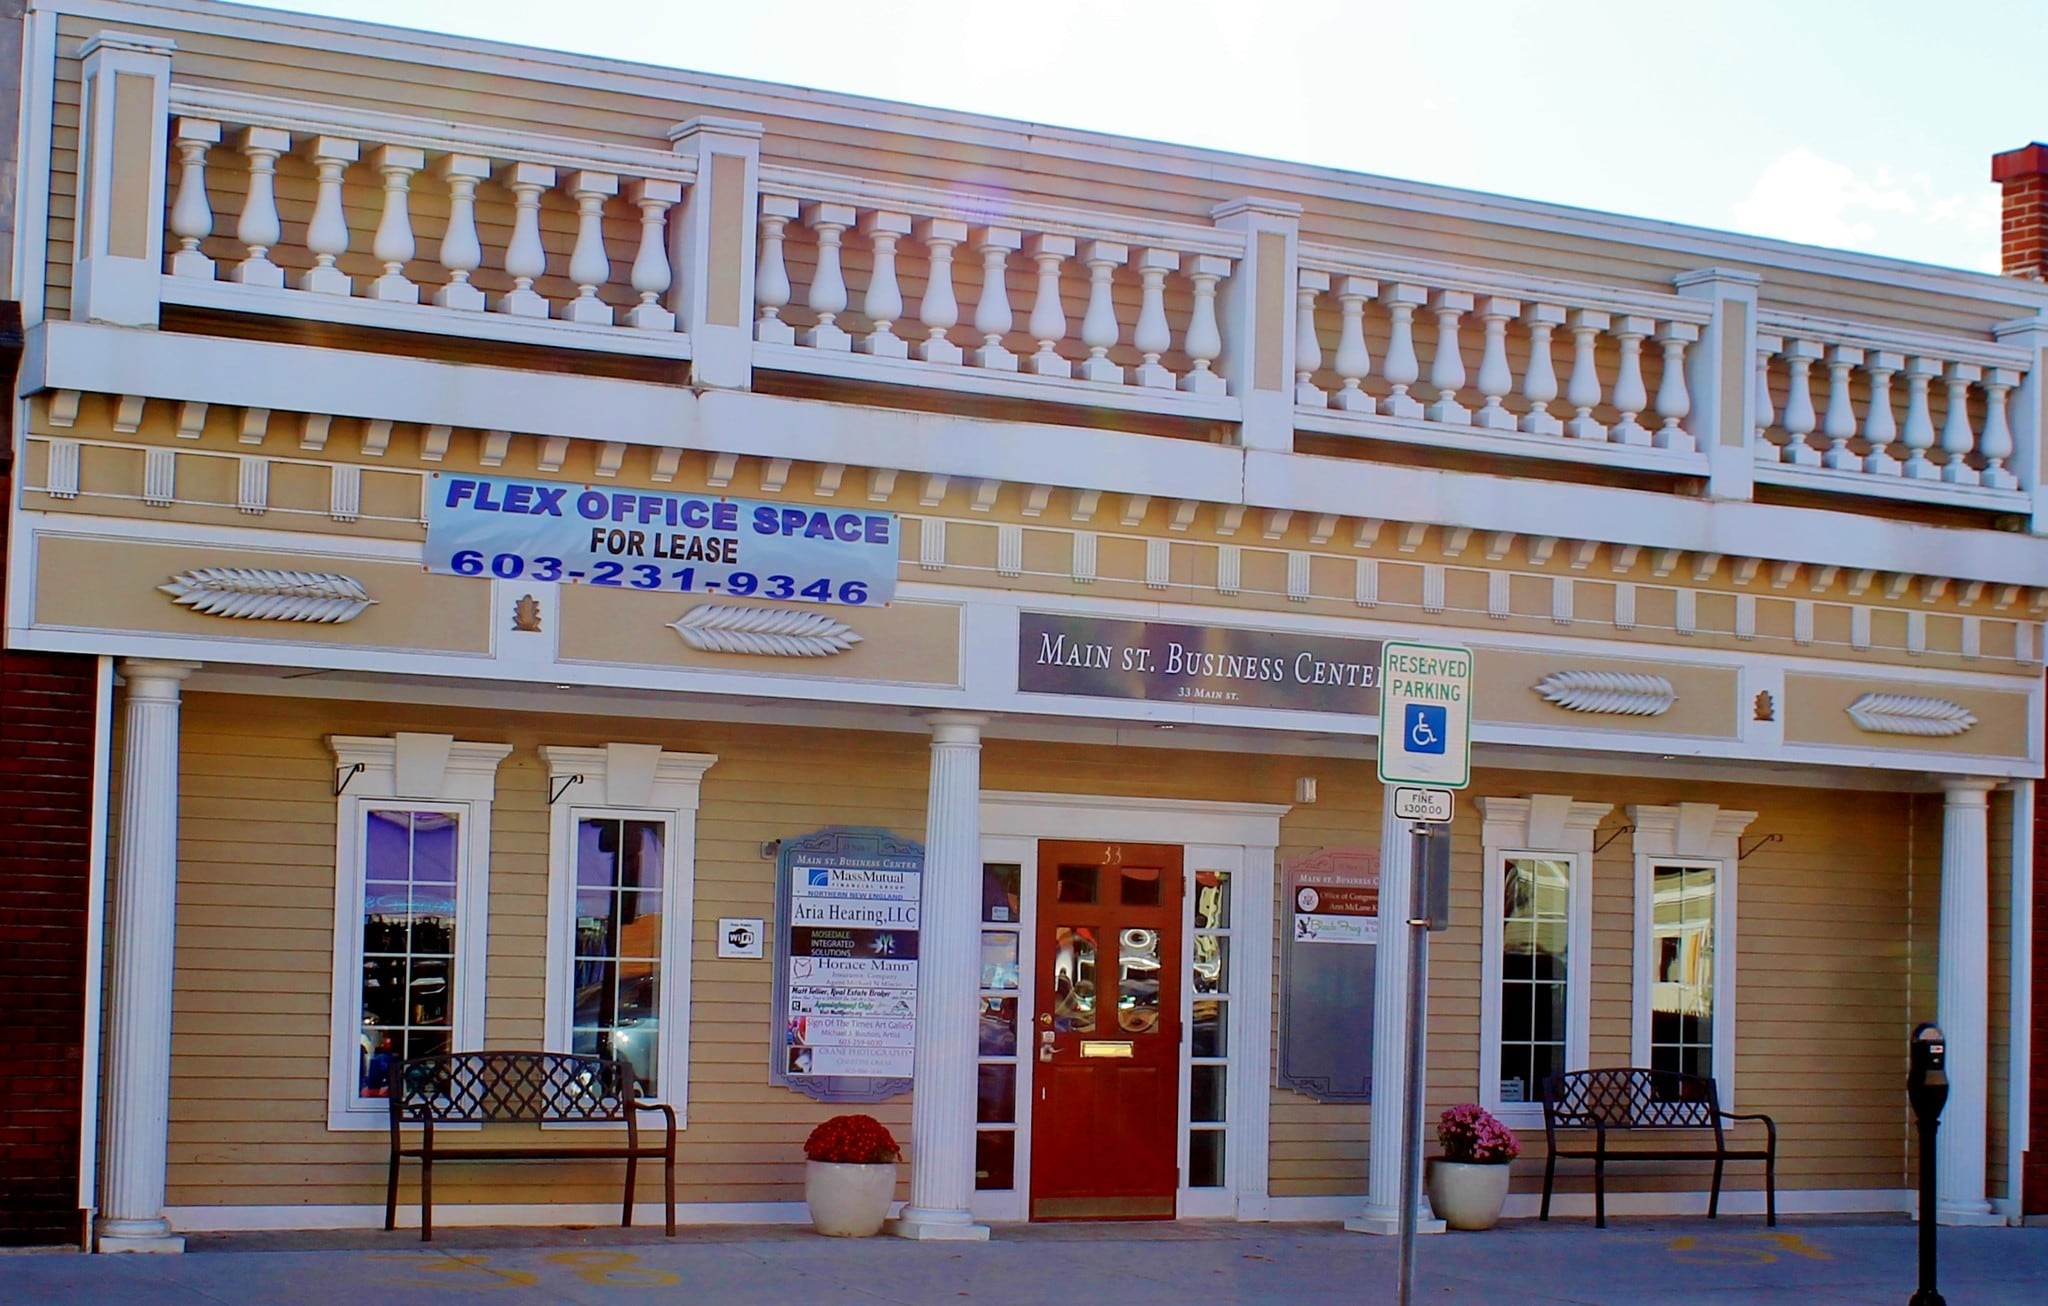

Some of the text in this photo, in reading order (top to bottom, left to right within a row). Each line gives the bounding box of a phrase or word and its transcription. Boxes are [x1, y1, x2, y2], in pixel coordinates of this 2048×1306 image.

[445, 479, 890, 544] FLEX OFFICE SPACE
[590, 527, 738, 564] FOR LEASE
[450, 549, 869, 604] 603-231-9346
[1037, 633, 1112, 669] MAIN
[1165, 642, 1284, 682] BUSINESS
[1389, 654, 1467, 678] RESERVED
[1178, 686, 1191, 697] 33
[1194, 687, 1223, 699] MAIN
[1392, 679, 1461, 702] PARKING
[1412, 794, 1434, 805] FINE
[797, 855, 822, 865] MAIN
[840, 857, 880, 868] BUSINESS
[883, 859, 917, 869] CENTER
[1102, 846, 1121, 865] 33
[832, 869, 904, 884] MassMutual
[808, 889, 904, 900] NORTHERN NEW ENGLAND
[794, 903, 824, 919] Aria
[811, 939, 855, 949] INTEGRATED
[811, 949, 851, 958] SOLUTIONS
[818, 958, 910, 972] Horace Mann
[807, 1018, 824, 1029] Sign
[825, 1018, 834, 1027] Of
[836, 1019, 849, 1027] The
[851, 1019, 873, 1028] Times
